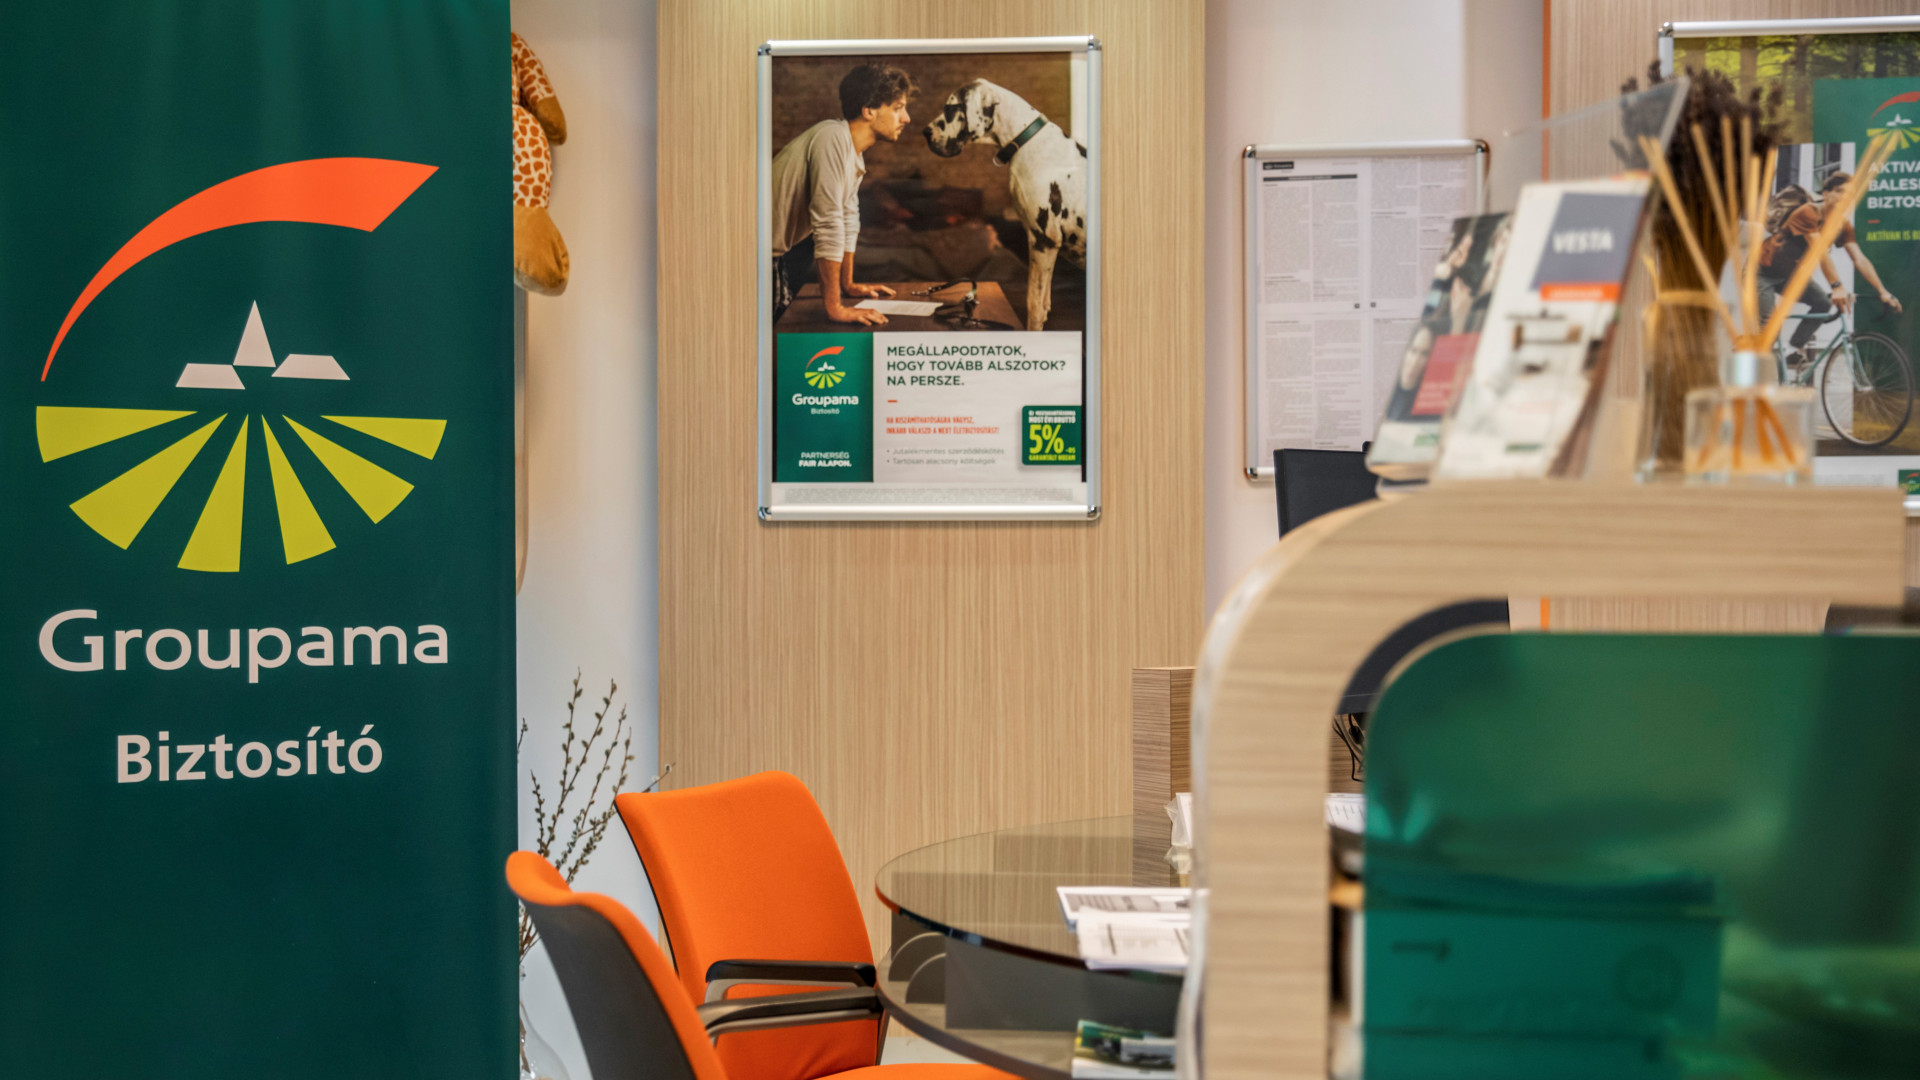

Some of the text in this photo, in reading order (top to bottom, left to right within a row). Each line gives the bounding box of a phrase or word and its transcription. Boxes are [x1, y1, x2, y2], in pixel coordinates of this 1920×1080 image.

[1868, 178, 1920, 191] BALES
[1553, 228, 1613, 254] VESTA
[887, 343, 1026, 357] MEGÁLLAPODTATOK,
[887, 359, 1066, 372] HOGY TOVÁBB ALSZOTOK?
[887, 375, 965, 386] NA PERSZE.
[791, 393, 860, 408] Groupama
[1029, 424, 1065, 454] 5%
[800, 451, 850, 460] PARTNERSÉG
[817, 459, 852, 468] ALAPON.
[39, 608, 449, 684] Groupama
[116, 723, 383, 784] Biztosító
